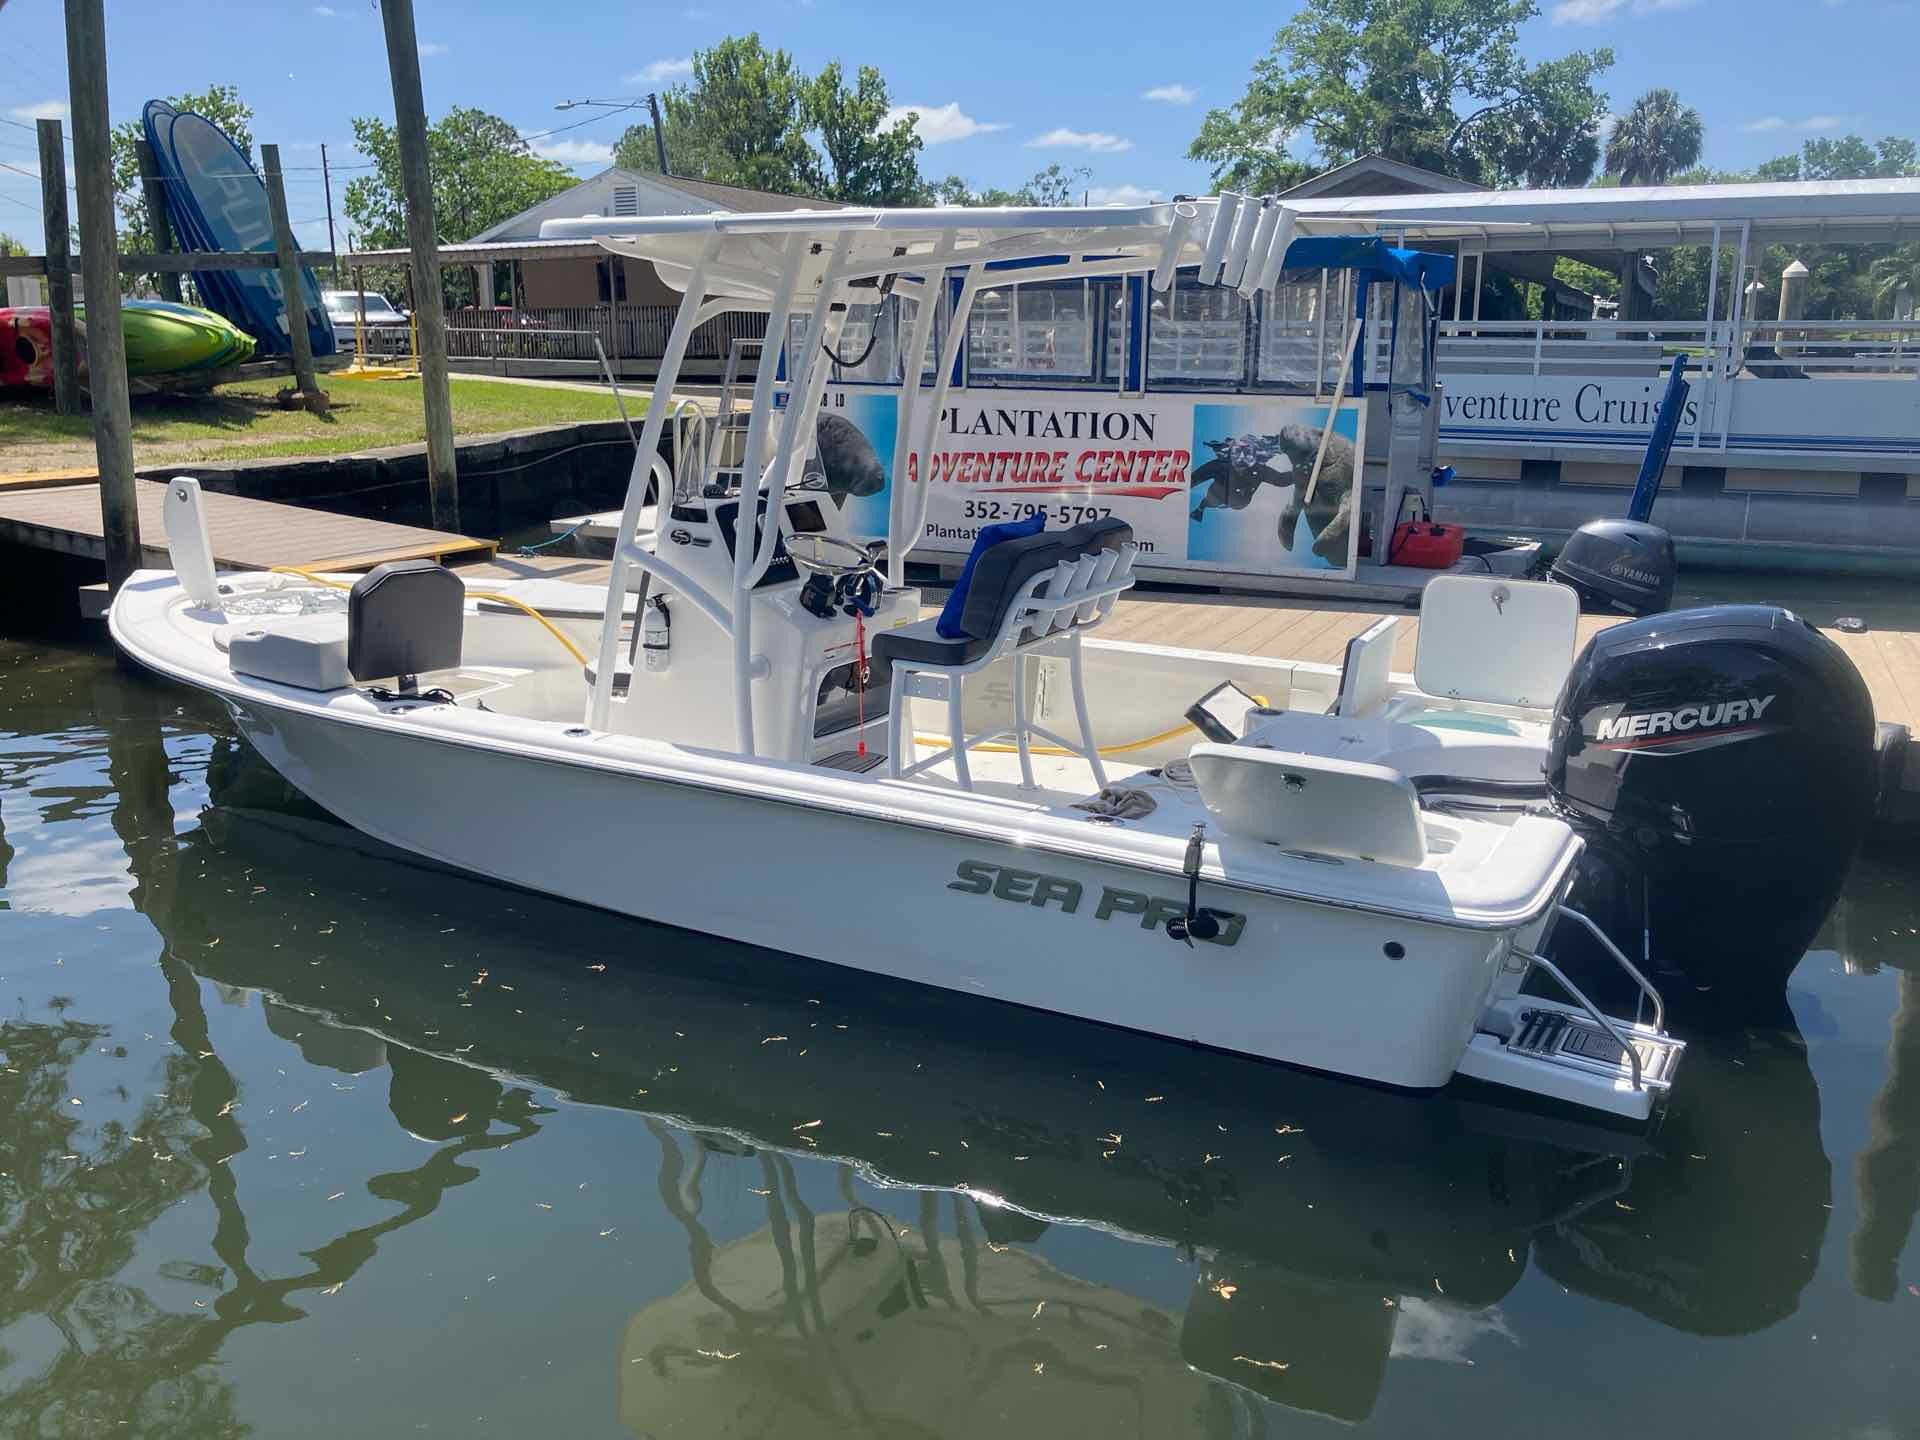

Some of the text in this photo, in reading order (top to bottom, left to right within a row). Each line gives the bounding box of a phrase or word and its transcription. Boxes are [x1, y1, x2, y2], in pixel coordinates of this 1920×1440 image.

[1445, 383, 1698, 426] venture Cruiss
[1074, 449, 1191, 483] CENTER
[1596, 695, 1776, 741] MERCURY
[946, 859, 1083, 914] SEA
